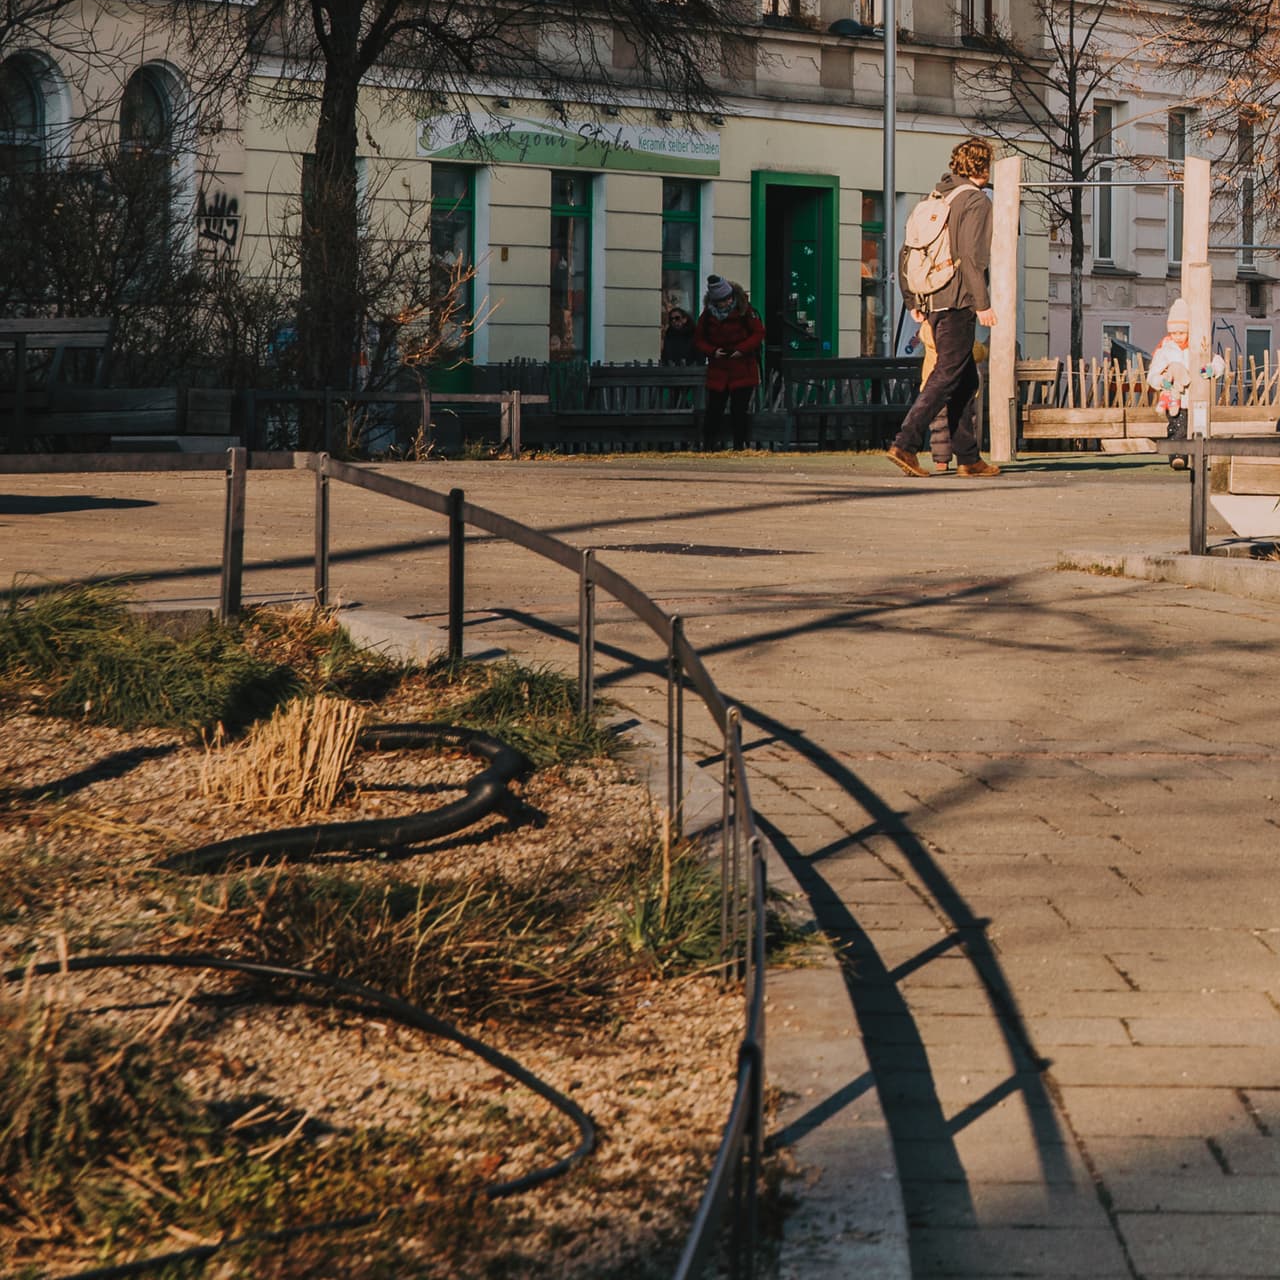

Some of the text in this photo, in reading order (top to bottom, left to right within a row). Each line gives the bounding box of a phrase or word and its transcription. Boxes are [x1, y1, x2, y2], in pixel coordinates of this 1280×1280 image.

[518, 132, 568, 162] your
[577, 123, 634, 166] Style
[638, 135, 667, 151] Keramik
[668, 138, 689, 153] selber
